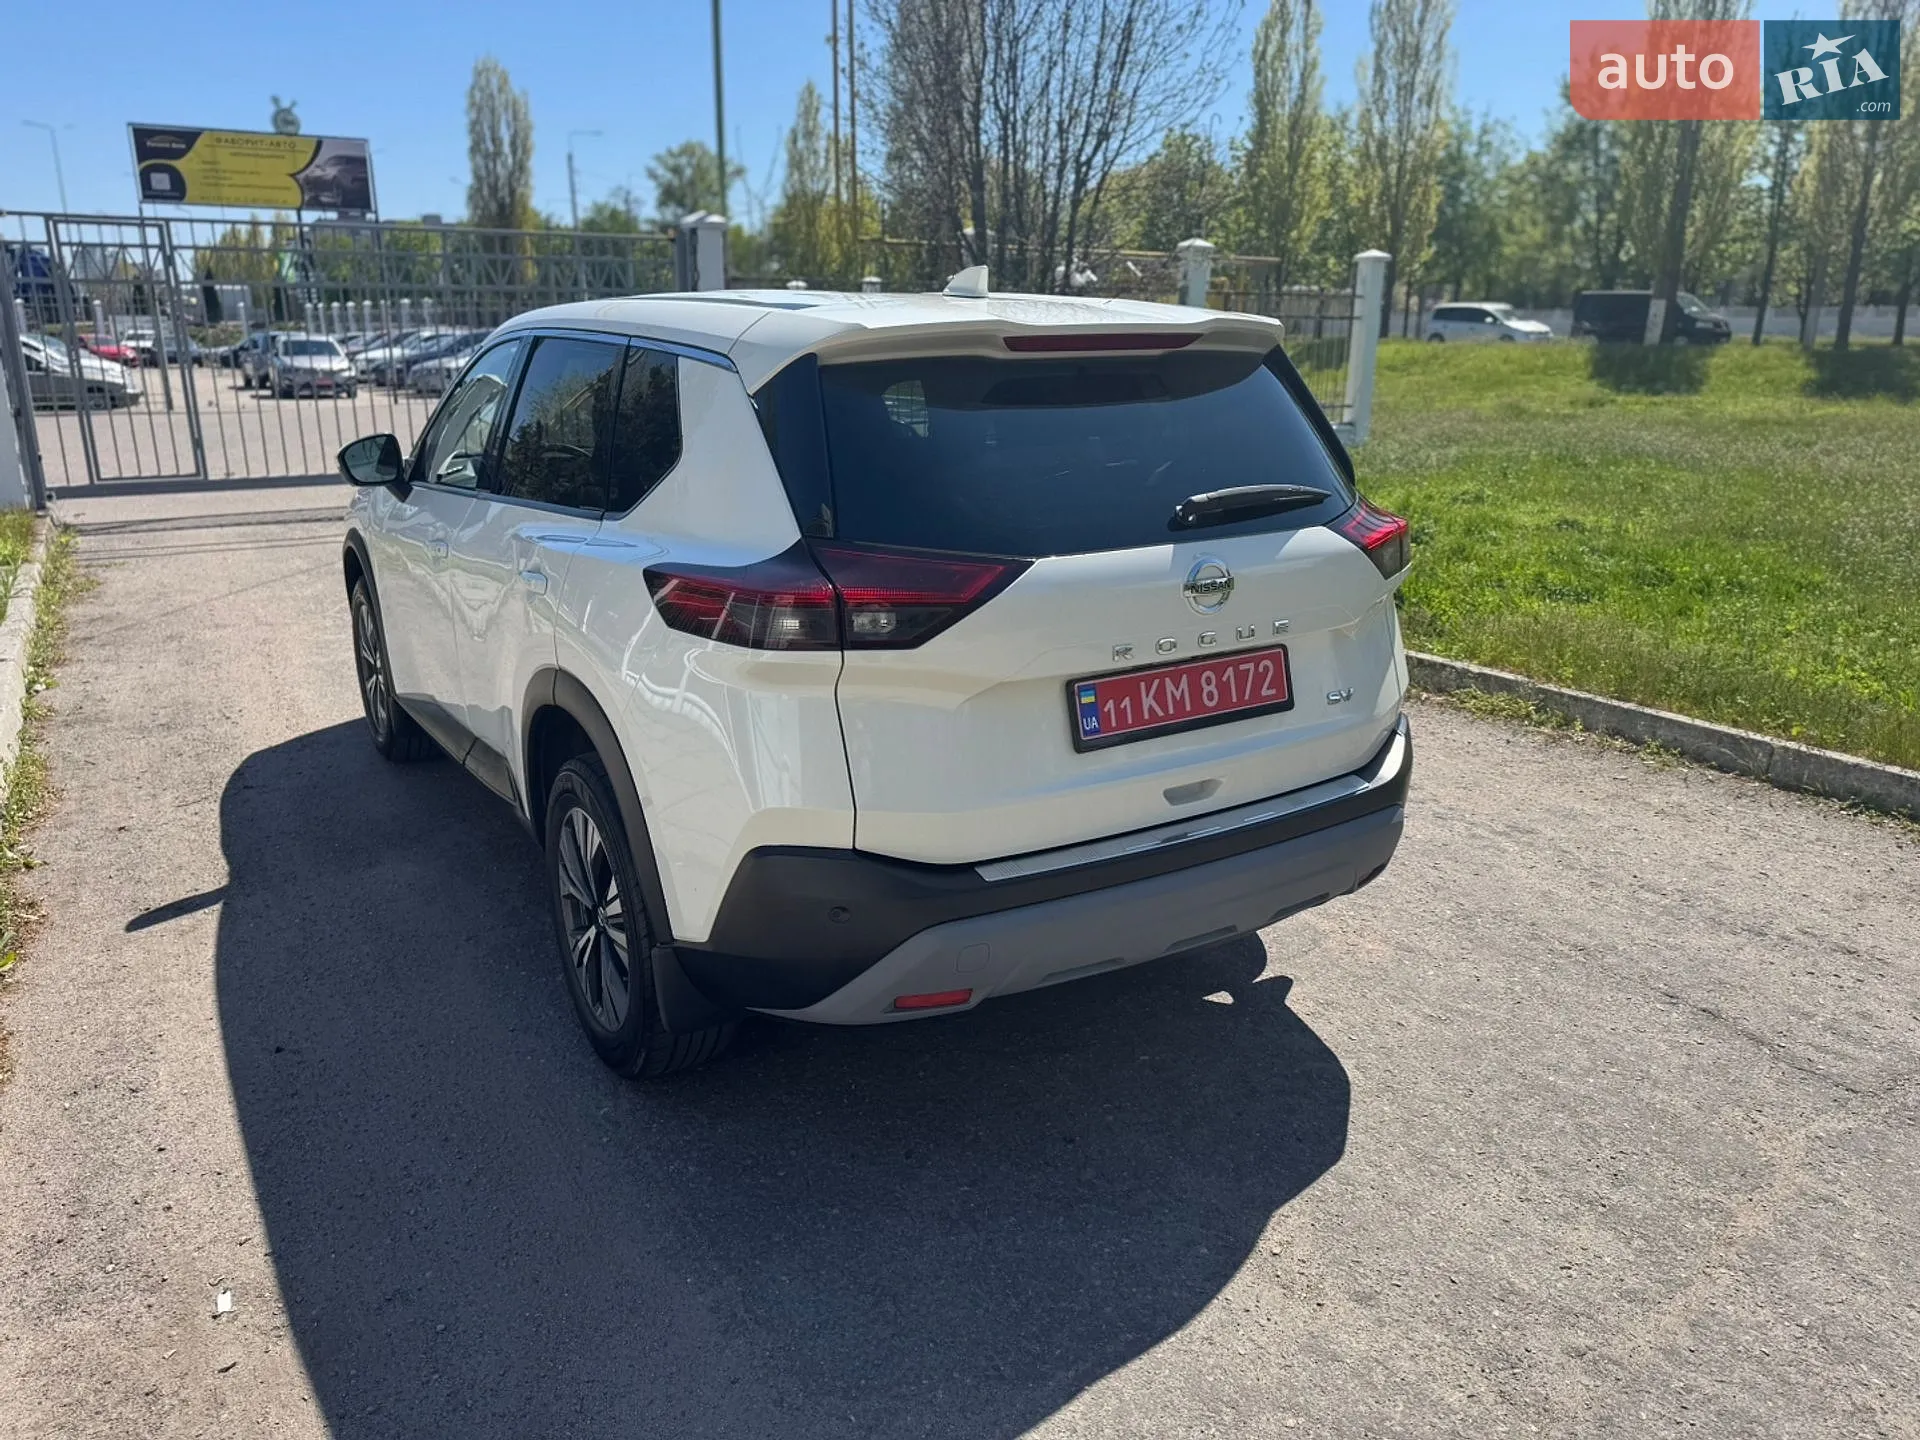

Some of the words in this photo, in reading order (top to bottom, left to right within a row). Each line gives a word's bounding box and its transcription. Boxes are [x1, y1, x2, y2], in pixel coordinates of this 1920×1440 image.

[1190, 577, 1234, 596] NISSAN
[1111, 618, 1291, 662] ROGUE
[1200, 659, 1278, 708] 8172
[1326, 687, 1355, 706] SV
[1082, 716, 1099, 731] UA
